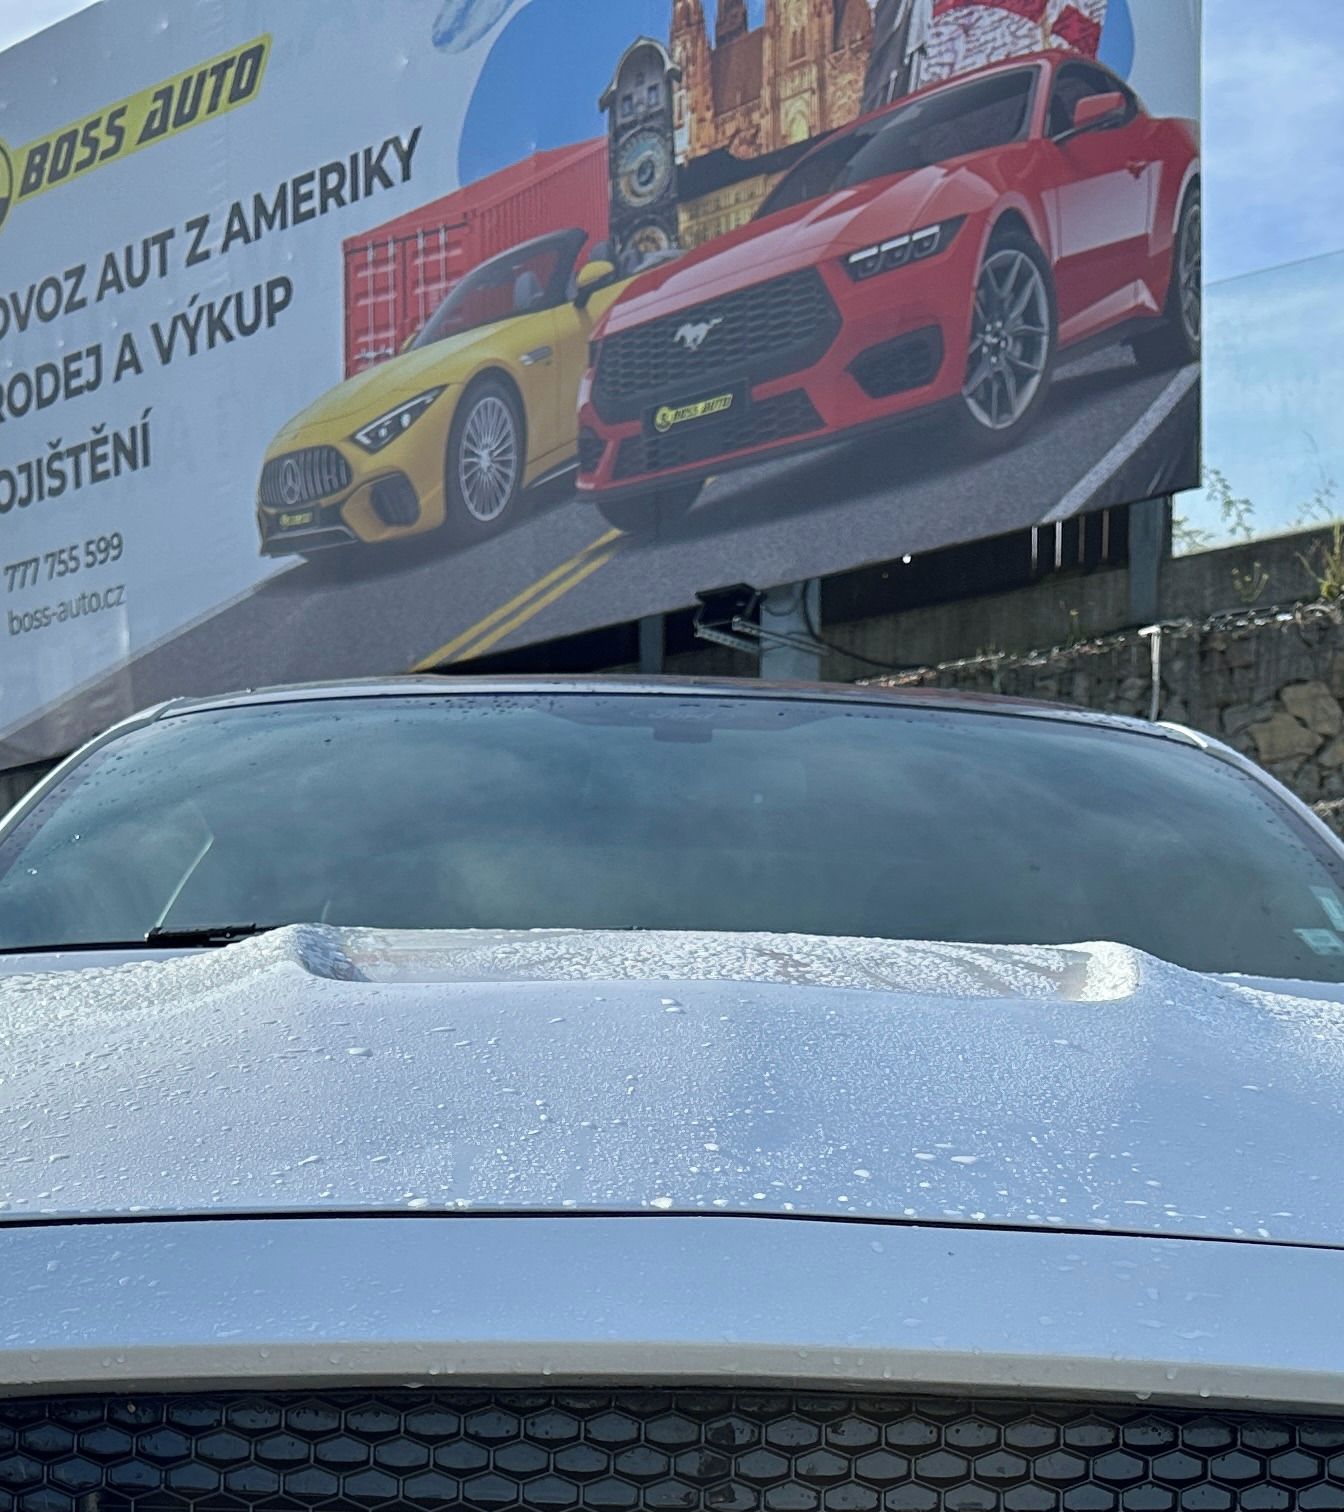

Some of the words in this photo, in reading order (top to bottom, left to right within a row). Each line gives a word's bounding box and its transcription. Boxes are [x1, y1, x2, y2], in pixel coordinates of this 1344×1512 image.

[18, 107, 127, 199] BOSS
[137, 42, 266, 146] AUTO
[95, 229, 175, 303] AUT
[185, 215, 211, 267] Z
[220, 126, 423, 254] AMERIKY
[113, 333, 143, 383] A
[151, 275, 294, 364] VÝKUP
[4, 556, 41, 592] 777
[44, 544, 81, 581] 755
[85, 532, 124, 567] 599
[7, 584, 125, 636] boss-auto.cz
